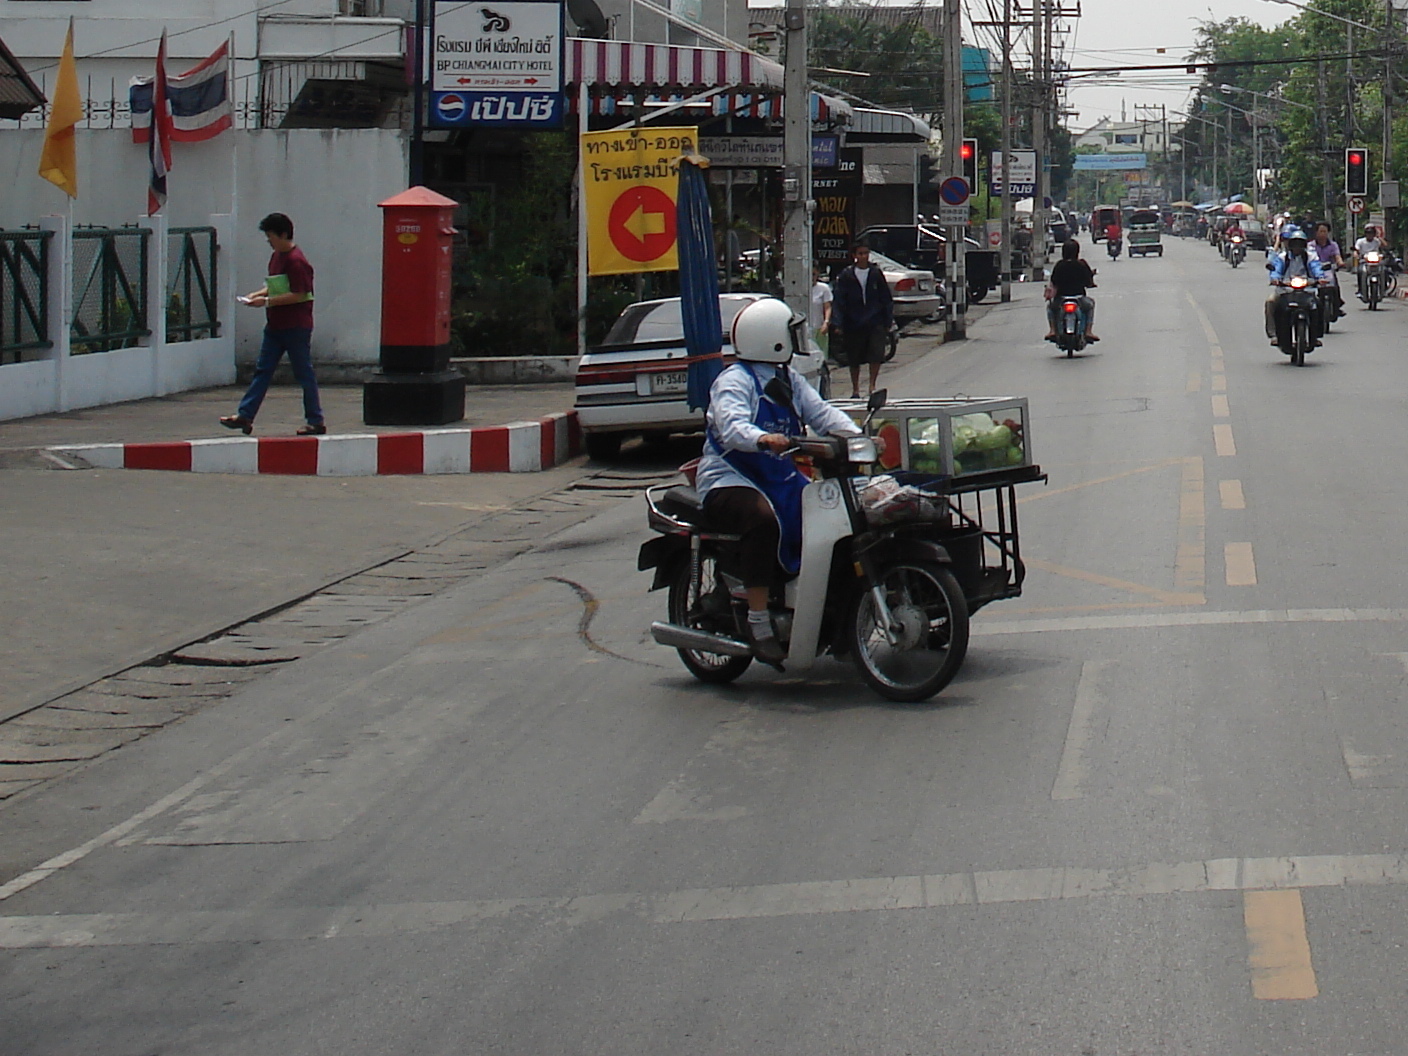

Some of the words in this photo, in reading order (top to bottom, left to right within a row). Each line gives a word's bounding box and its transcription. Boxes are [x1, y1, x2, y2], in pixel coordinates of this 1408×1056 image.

[436, 35, 471, 53] โรงแรม
[494, 36, 532, 54] เชียงใหม่
[437, 59, 451, 71] BP
[453, 60, 501, 71] CHIANGMAI
[503, 60, 525, 71] CITY
[526, 60, 553, 71] HOTEL
[821, 238, 845, 248] TOP
[817, 249, 849, 259] WEST
